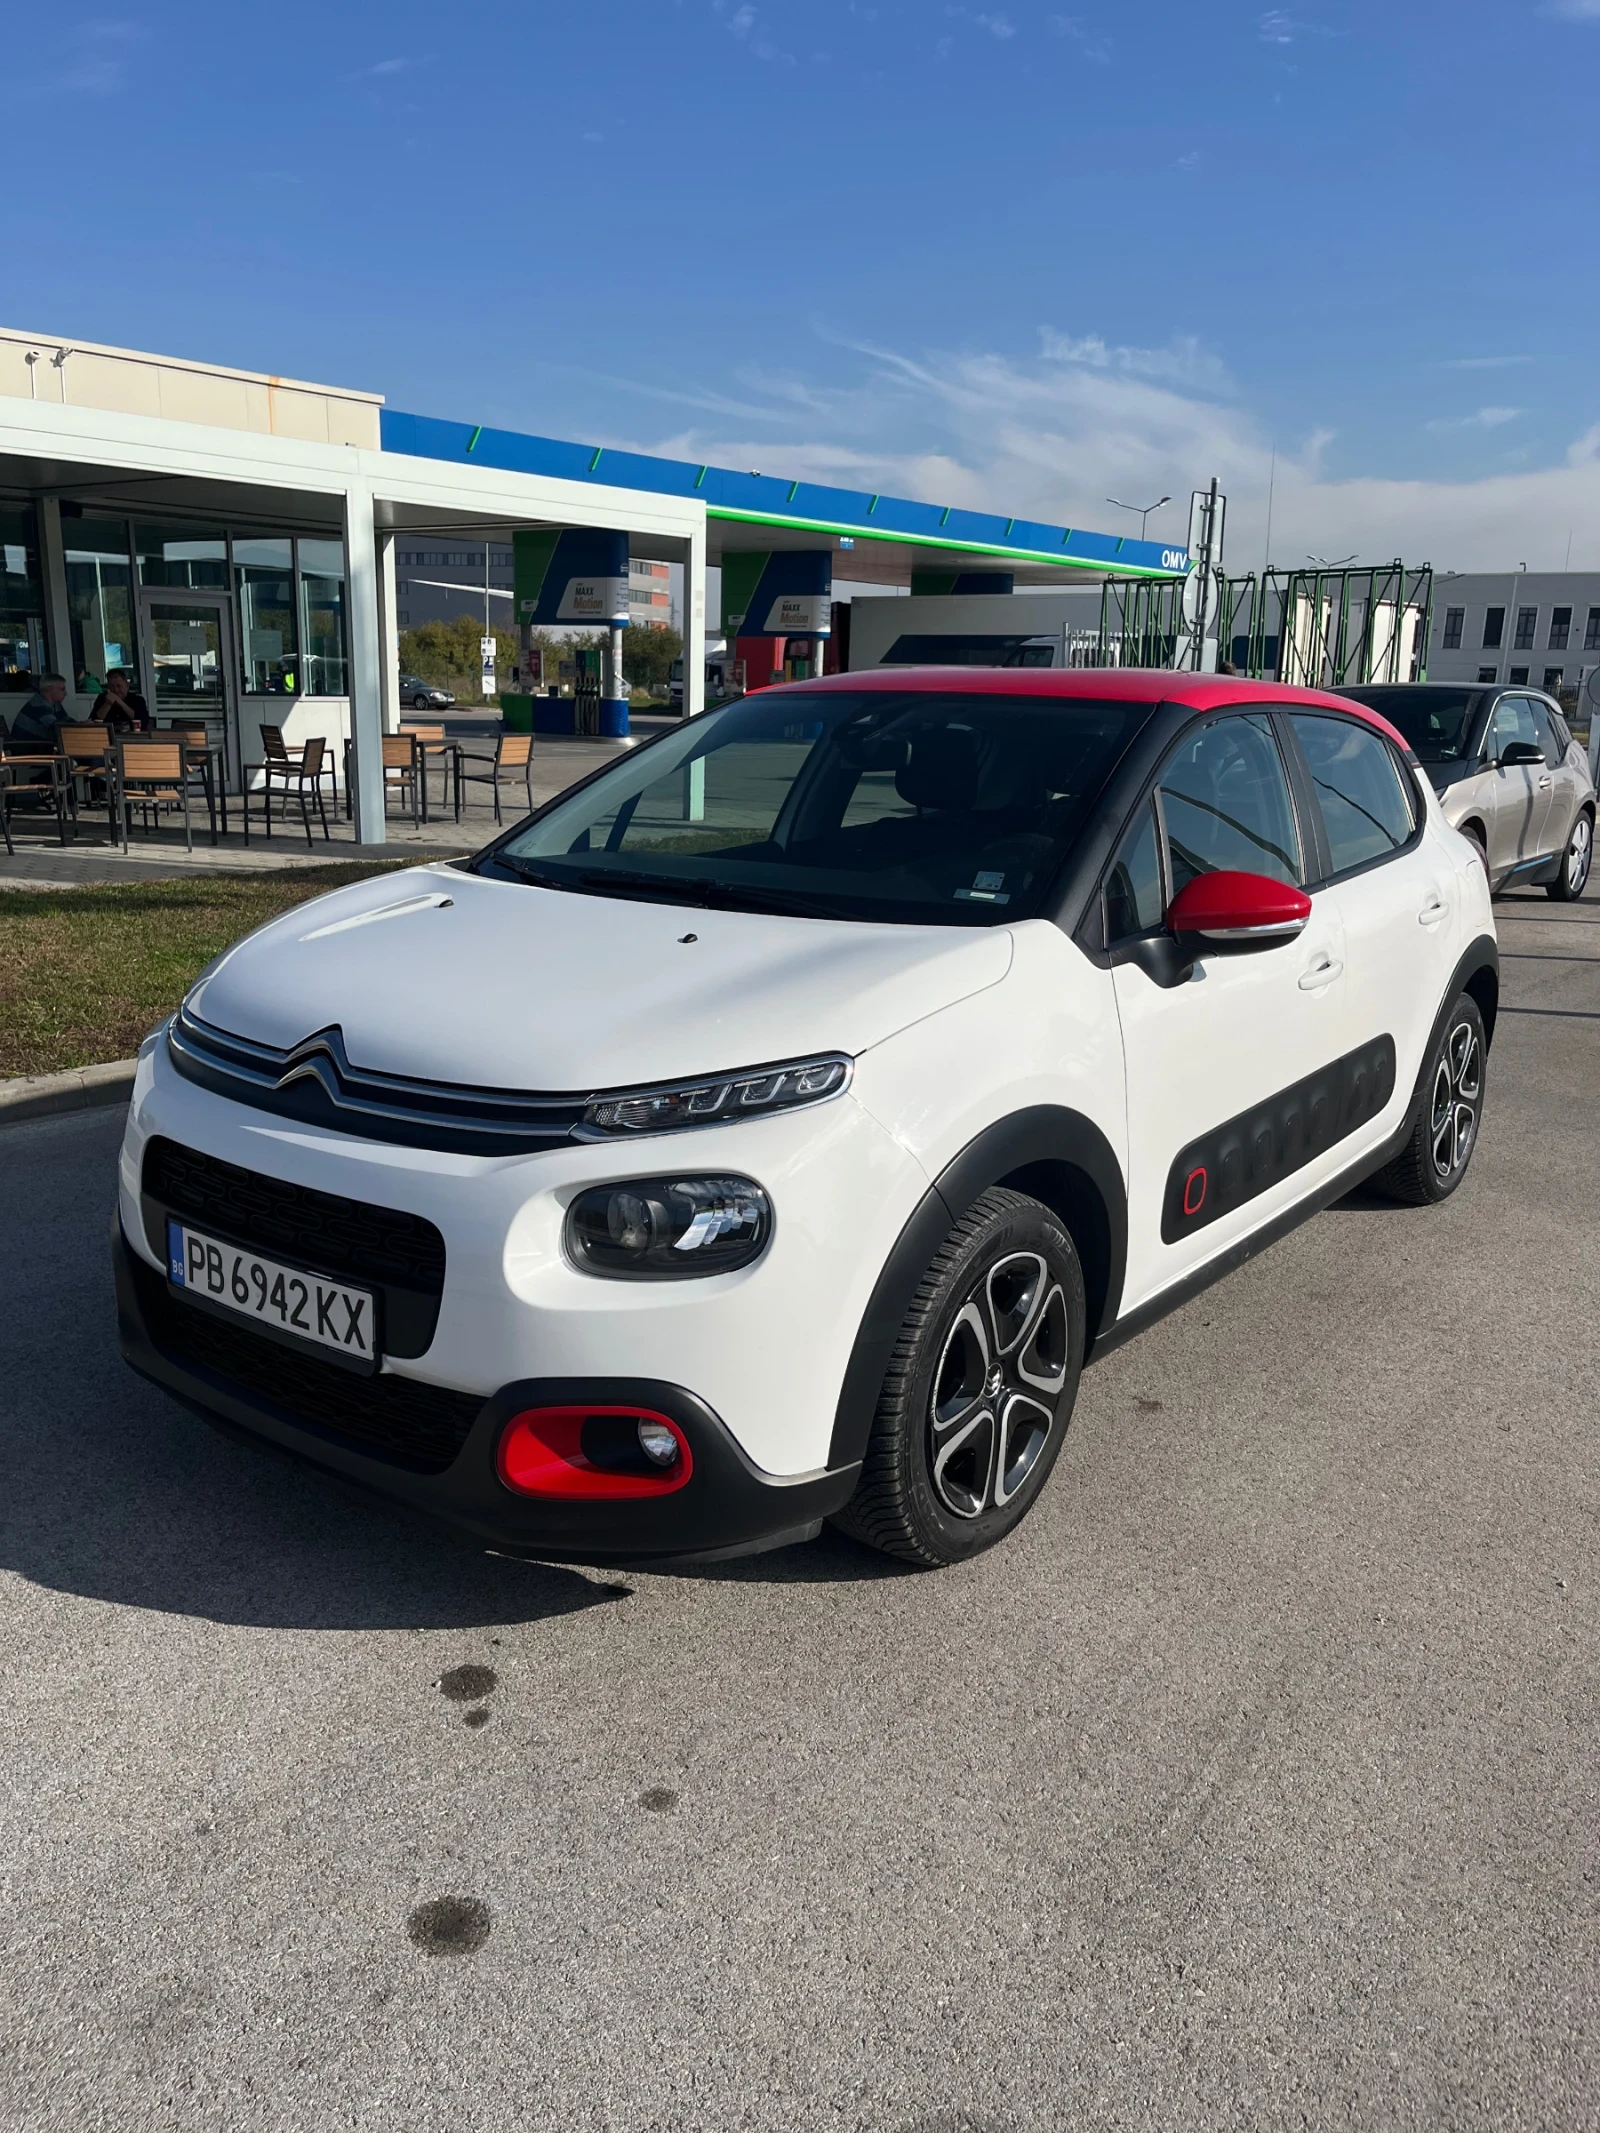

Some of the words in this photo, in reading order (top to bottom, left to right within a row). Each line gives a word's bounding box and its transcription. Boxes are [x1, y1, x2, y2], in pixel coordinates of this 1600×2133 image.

[1162, 549, 1188, 570] OMV
[575, 586, 594, 596] MAXX
[573, 597, 603, 609] Motion
[782, 603, 801, 612] MAXX
[780, 612, 808, 624] Motion
[171, 1259, 184, 1276] BG
